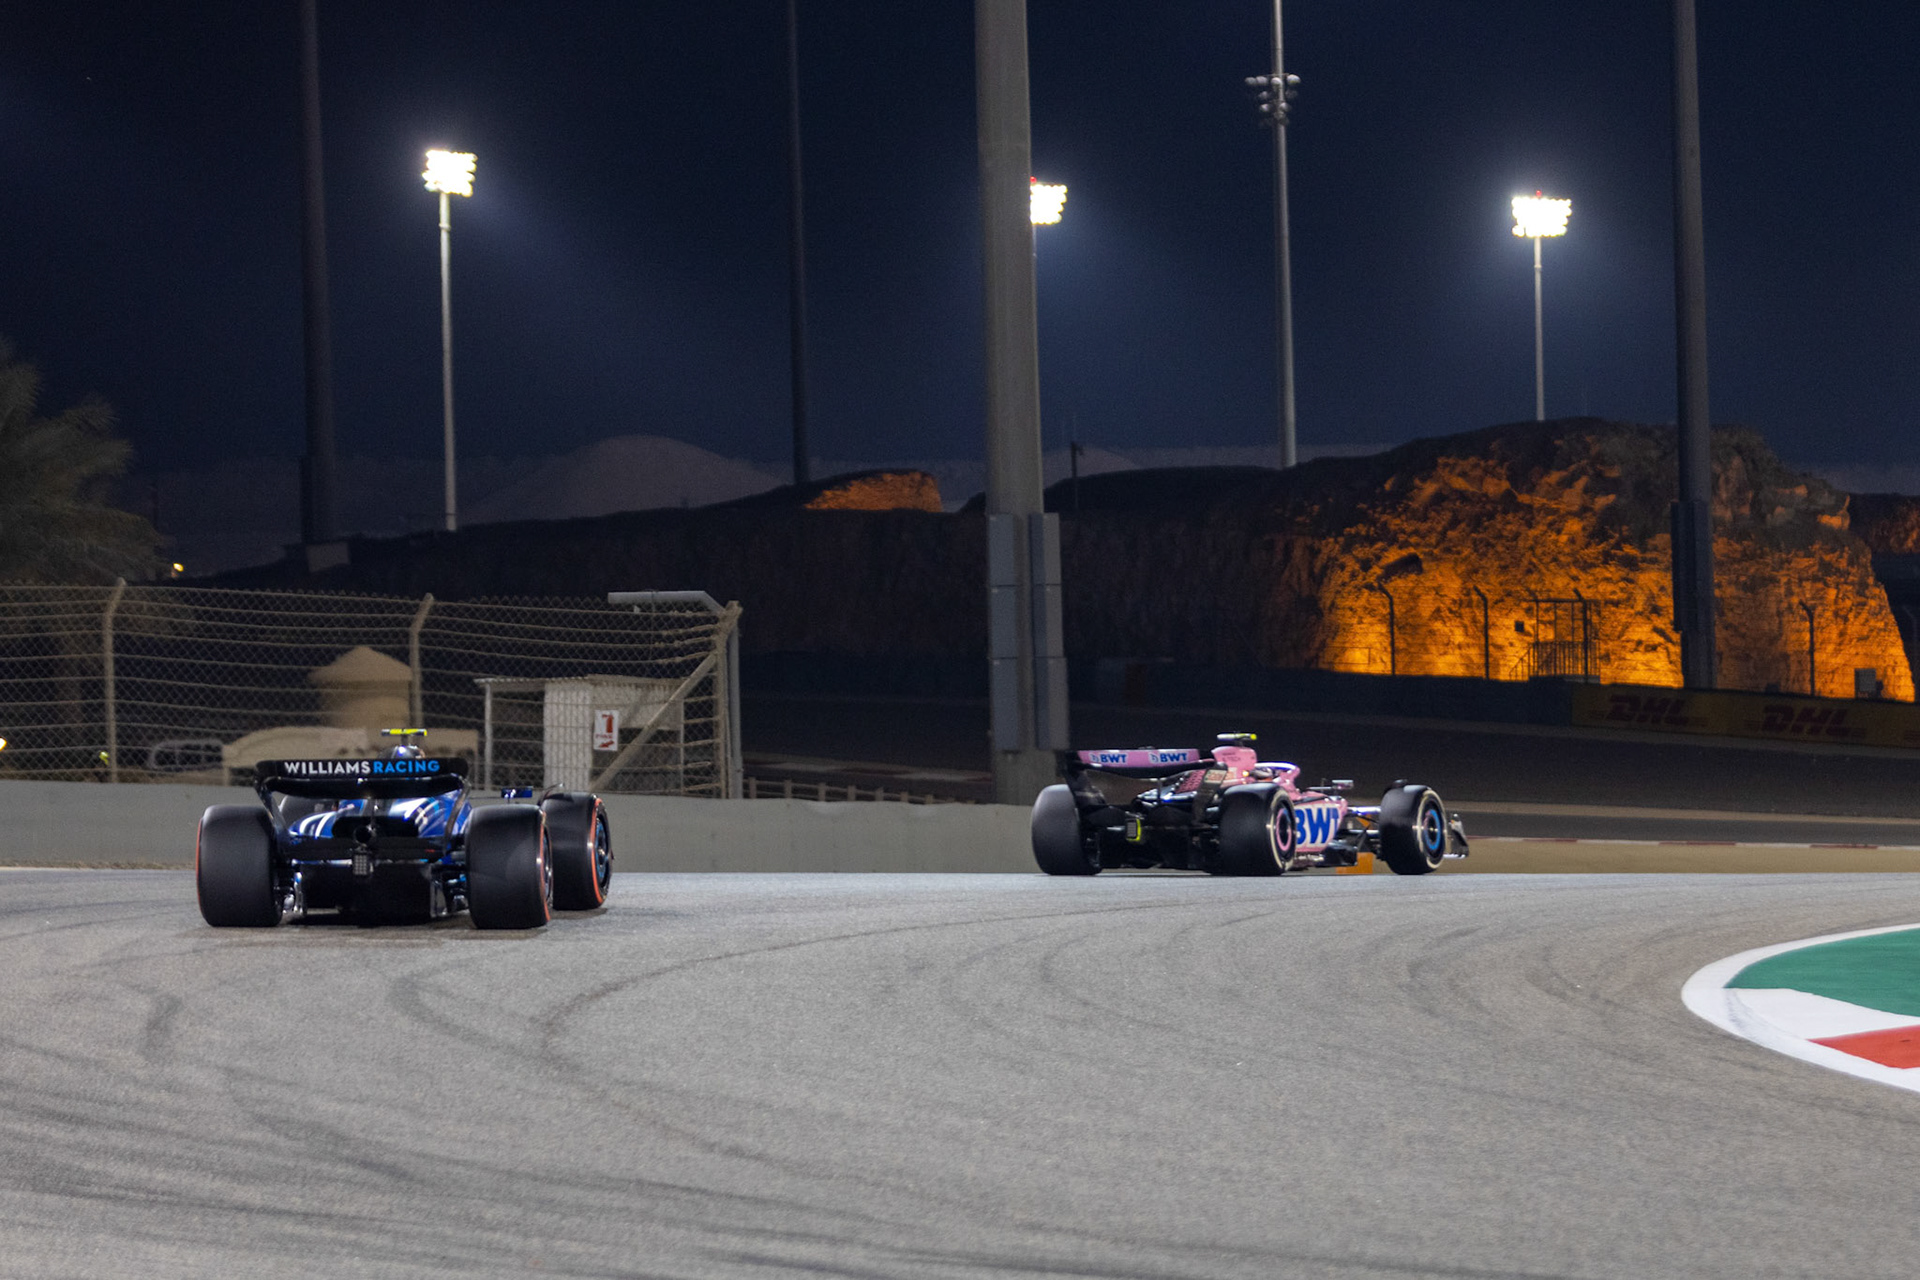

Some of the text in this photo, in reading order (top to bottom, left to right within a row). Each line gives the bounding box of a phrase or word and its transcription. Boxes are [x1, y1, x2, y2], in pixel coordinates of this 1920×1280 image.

[1606, 694, 1687, 727] DHL
[1762, 704, 1851, 738] DHL
[284, 760, 440, 774] WILLIAMS RACING
[1100, 754, 1127, 763] BWT
[1160, 753, 1187, 762] BWT
[1294, 807, 1340, 845] BWT
